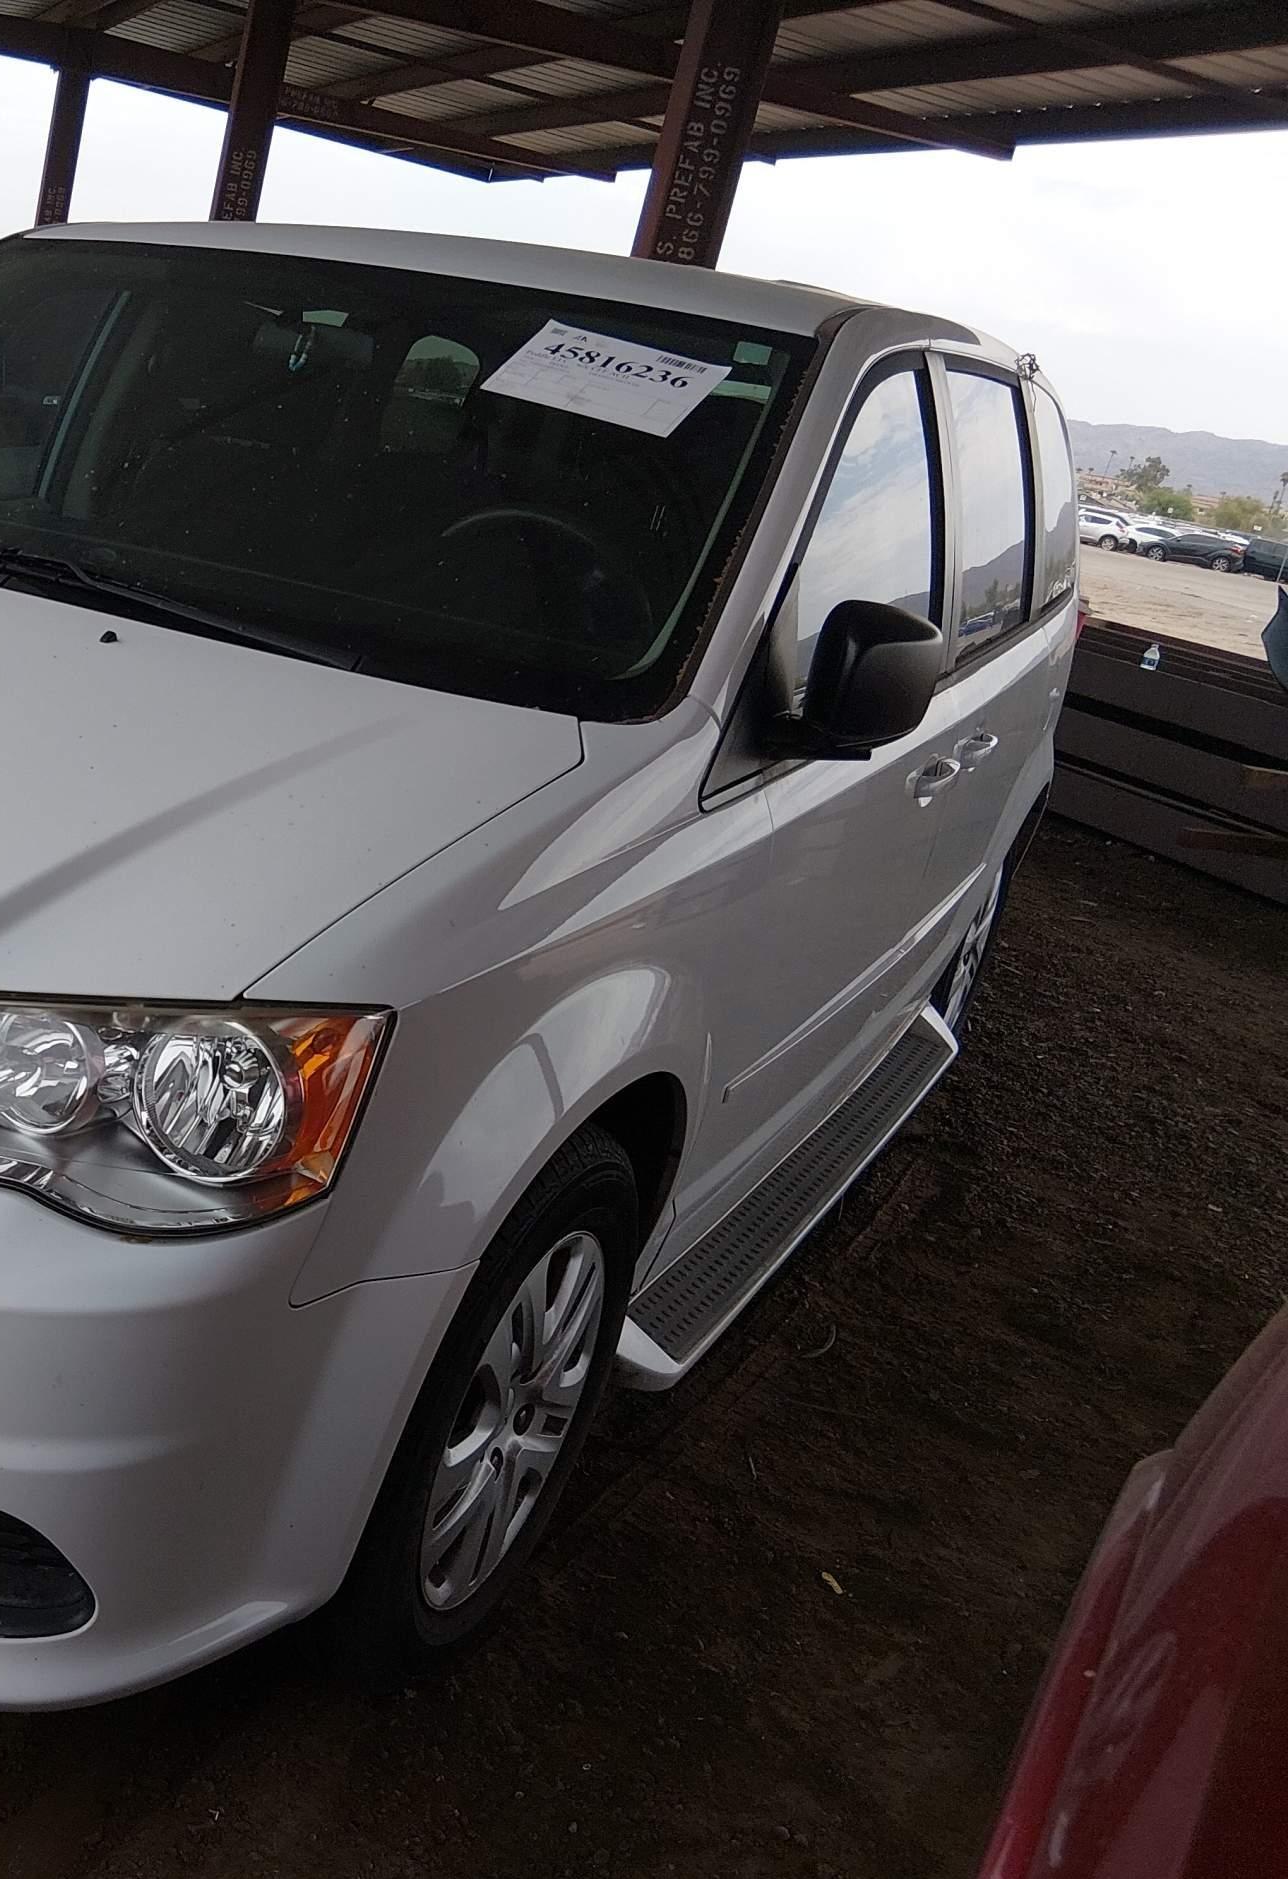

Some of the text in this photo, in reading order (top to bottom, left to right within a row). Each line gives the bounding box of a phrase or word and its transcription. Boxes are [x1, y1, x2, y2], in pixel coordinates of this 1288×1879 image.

[664, 121, 705, 221] PREFAB
[677, 66, 741, 261] 866-799-0969
[543, 342, 690, 389] 45816236
